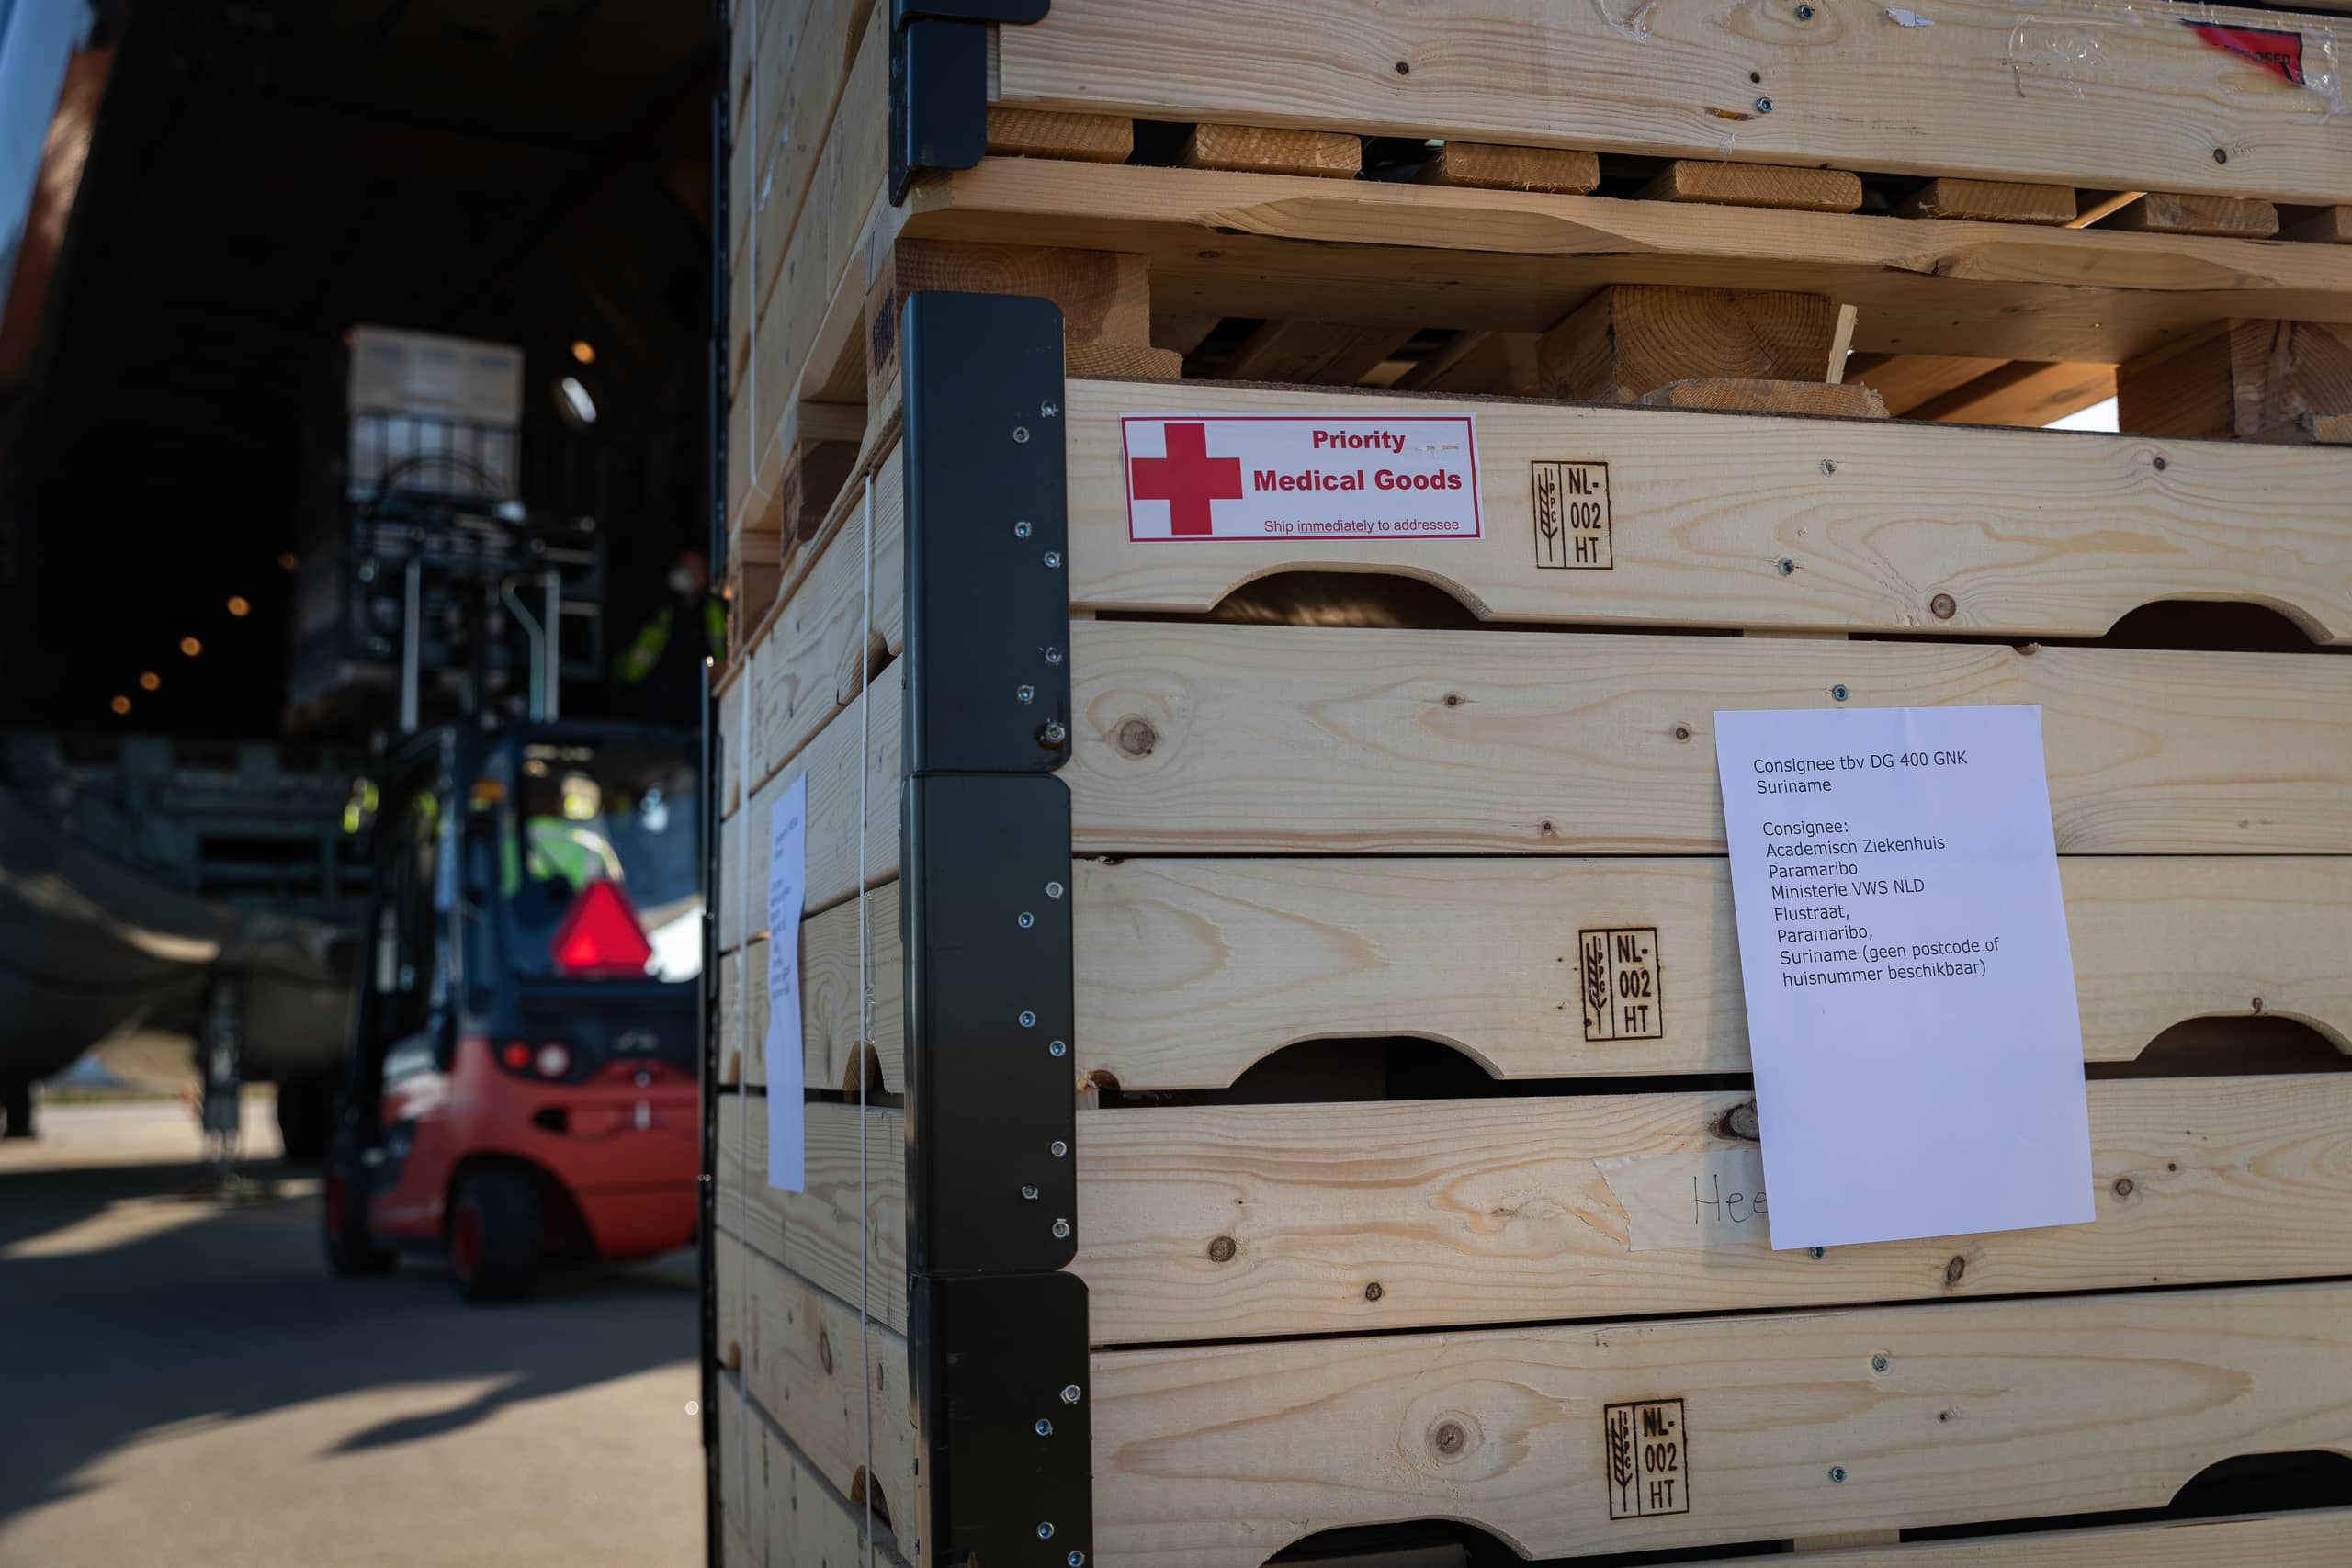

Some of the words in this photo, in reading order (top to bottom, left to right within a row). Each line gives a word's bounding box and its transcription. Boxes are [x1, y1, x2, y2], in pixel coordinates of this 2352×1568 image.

[1312, 430, 1406, 454] Priority
[1253, 469, 1365, 491] Medical
[1374, 469, 1463, 491] Goods
[1568, 468, 1599, 495] NL-
[1548, 469, 1557, 523] IPPC
[1263, 520, 1294, 535] Ship
[1297, 519, 1374, 535] immediately
[1378, 520, 1390, 532] to
[1394, 518, 1460, 532] addressee
[1570, 502, 1601, 529] 002
[1575, 536, 1599, 563] HT
[1753, 758, 1836, 774] Consignee
[1839, 755, 1865, 770] tbv
[1871, 753, 1894, 769] DG
[1899, 752, 1928, 767] 400
[1933, 750, 1968, 766] GNK
[1757, 779, 1832, 794] Suriname
[1762, 820, 1849, 838] Consignee:
[1766, 840, 1858, 857] Academisch
[1862, 836, 1946, 853] Ziekenhuis
[1769, 861, 1858, 879] Paramaribo
[1771, 883, 1848, 900] Ministerie
[1852, 880, 1889, 897] VWS
[1894, 878, 1925, 894] NLD
[1774, 904, 1850, 921] Flustraat,
[1777, 924, 1873, 943] Paramaribo,
[1616, 934, 1648, 963] NL-
[1780, 946, 1857, 964] Suriname
[1862, 944, 1906, 964] (geen
[1912, 939, 1980, 959] postcode
[1984, 937, 2000, 952] of
[1597, 938, 1606, 993] IPPC
[1782, 967, 1883, 987] huisnummer
[1887, 959, 1986, 980] beschikbaar)
[1619, 970, 1651, 998] 002
[1624, 1005, 1649, 1033] HT
[1643, 1407, 1675, 1438] NL-
[1623, 1411, 1632, 1469] IPPC
[1645, 1442, 1678, 1473] 002
[1649, 1479, 1675, 1509] HT
